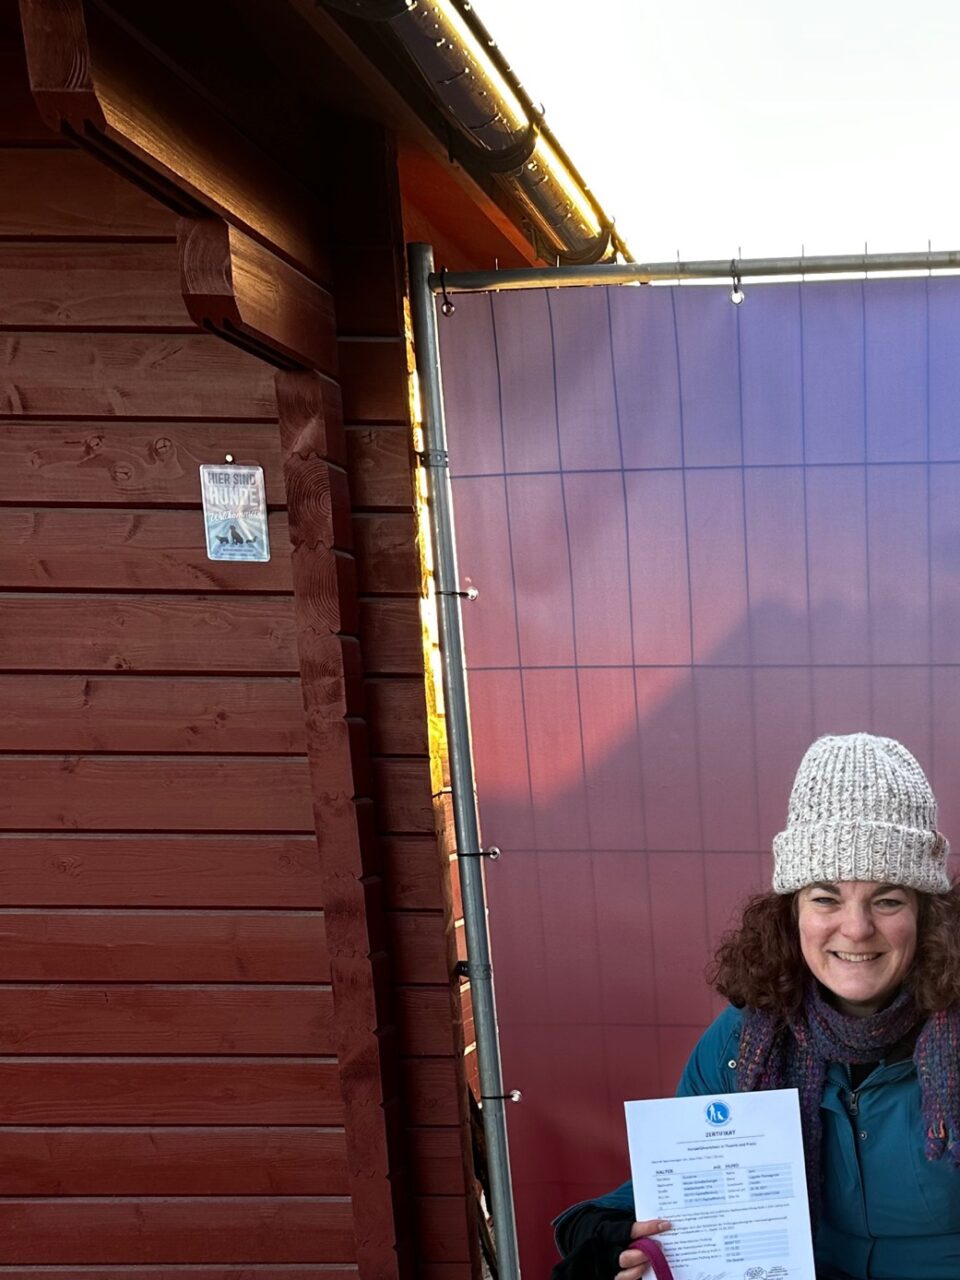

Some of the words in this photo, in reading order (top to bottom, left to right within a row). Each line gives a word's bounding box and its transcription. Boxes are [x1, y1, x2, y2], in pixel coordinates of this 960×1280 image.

[208, 472, 231, 485] HIER
[233, 473, 257, 486] SIND
[208, 486, 259, 506] HUNDE
